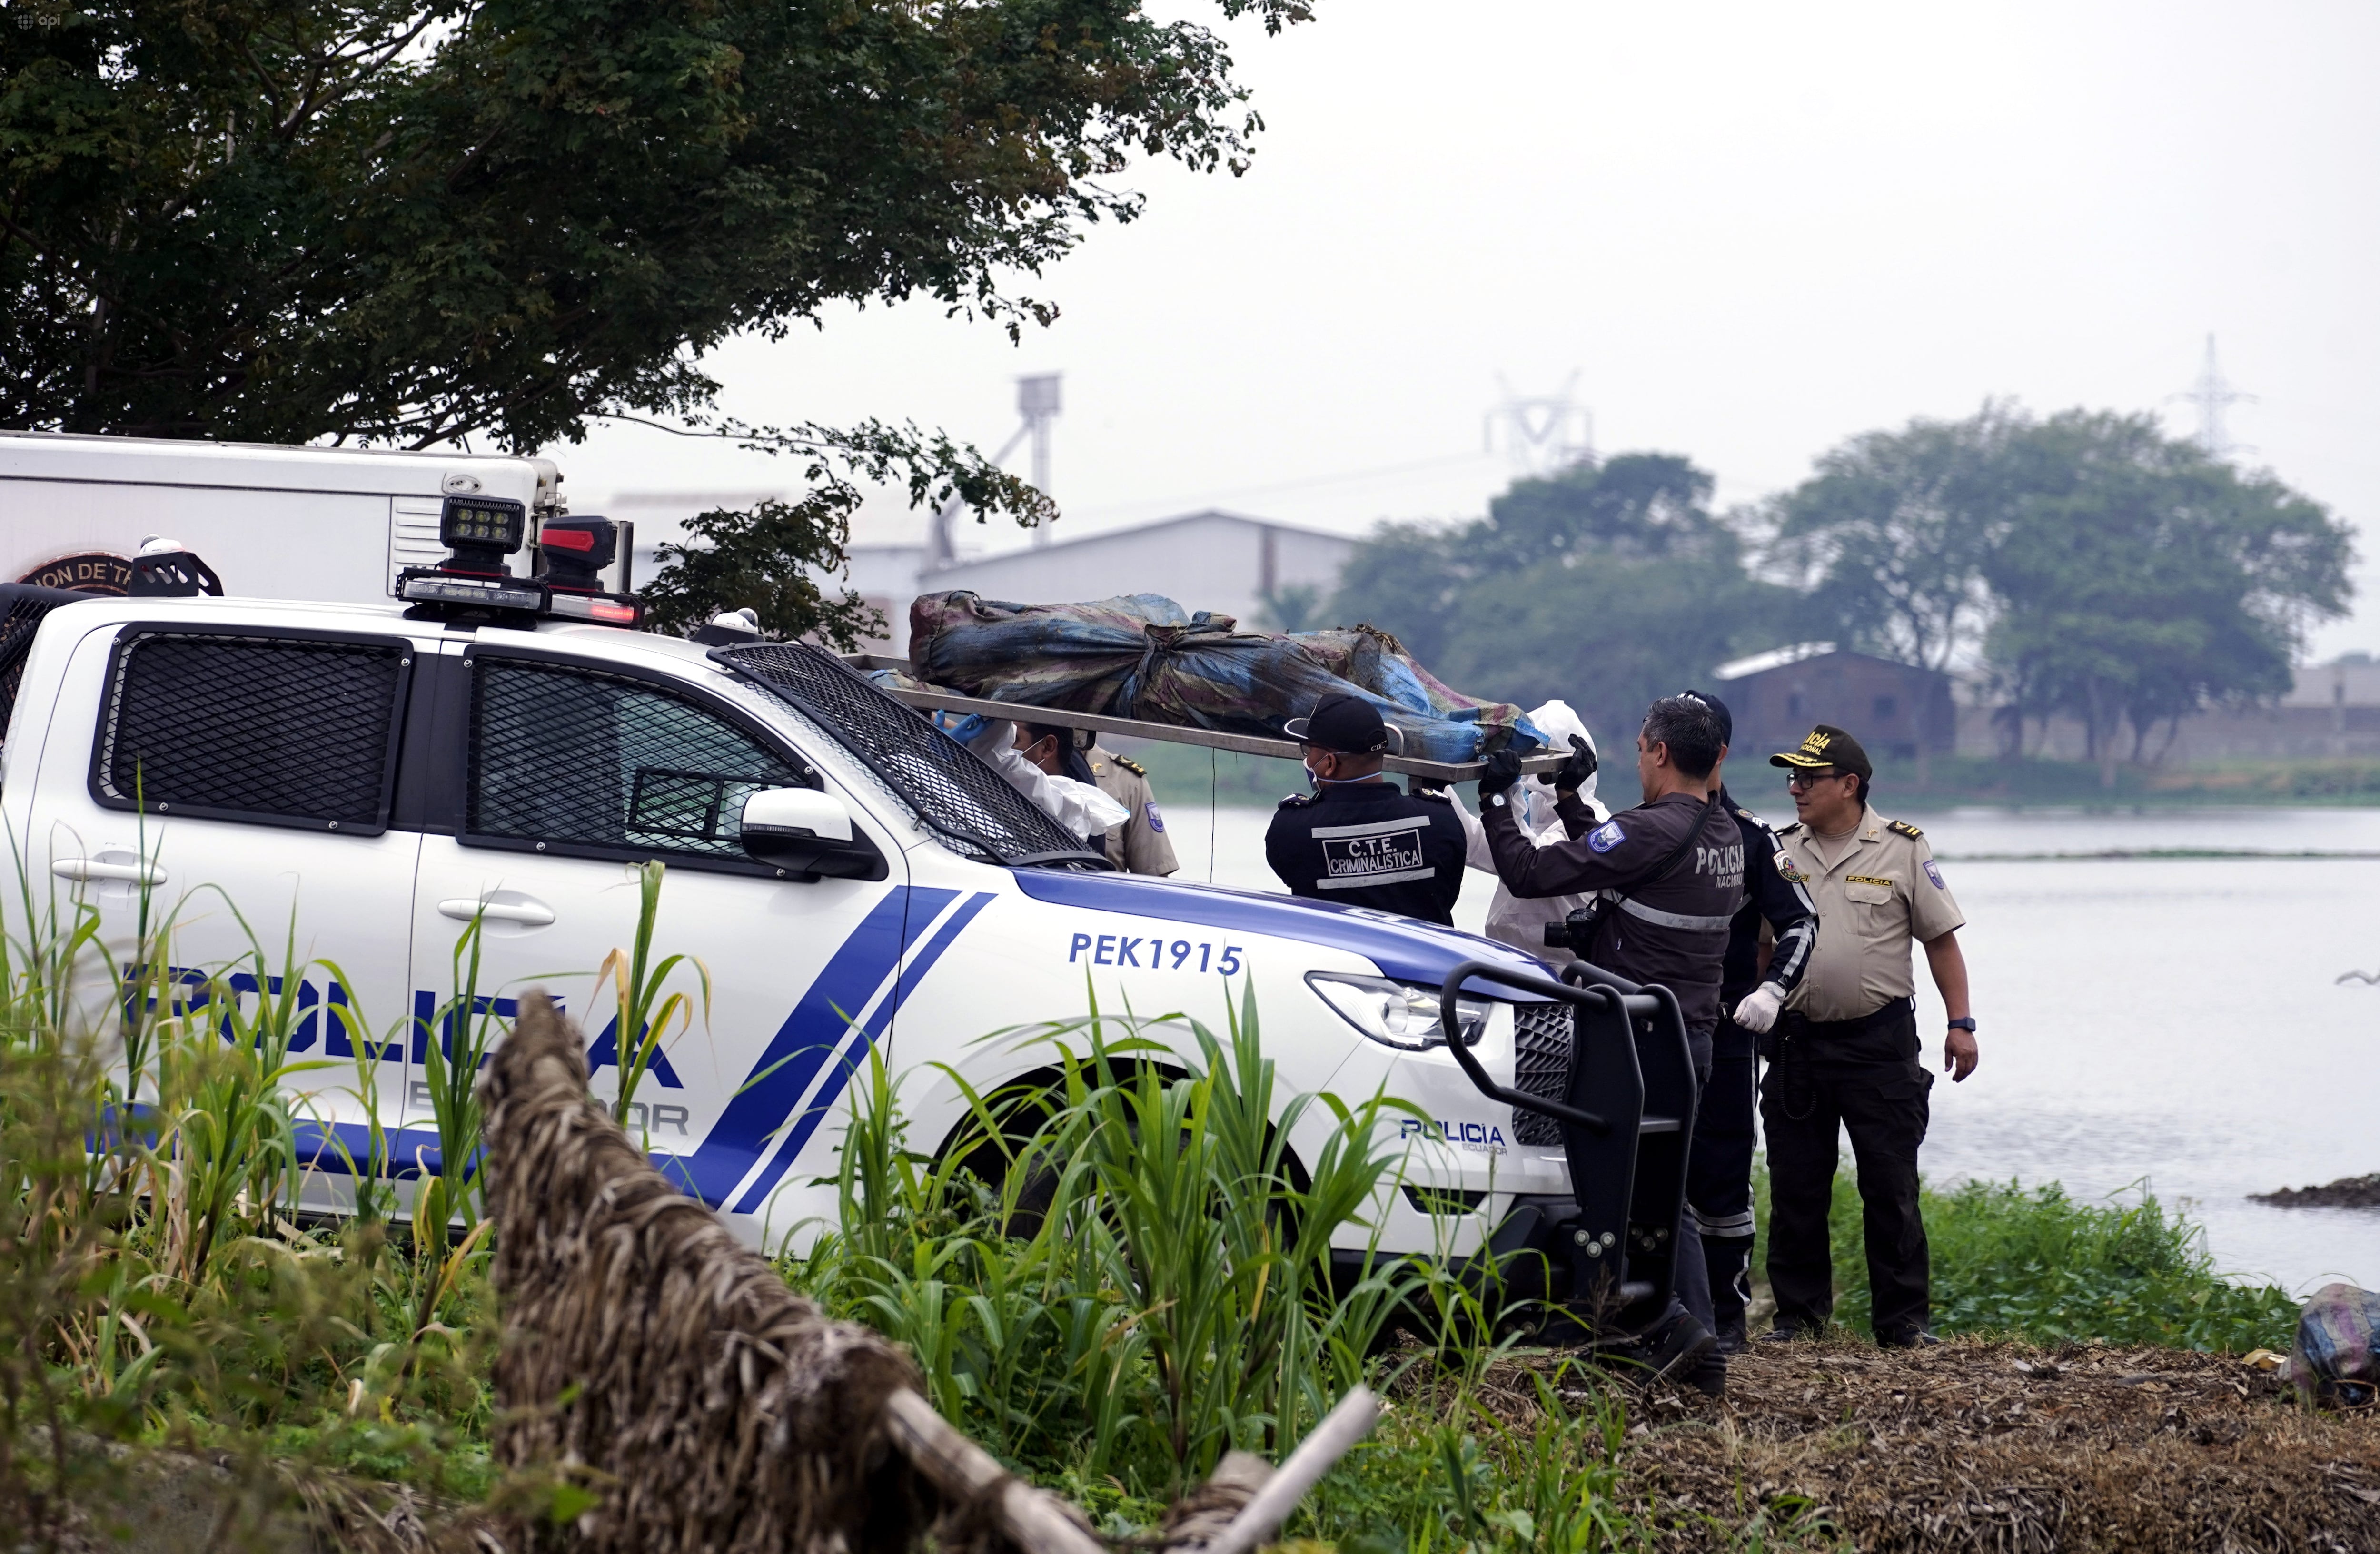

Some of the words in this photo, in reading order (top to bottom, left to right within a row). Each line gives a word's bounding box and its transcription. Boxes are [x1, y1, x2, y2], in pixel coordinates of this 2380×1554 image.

[78, 563, 107, 580] DE
[1348, 838, 1397, 857] C.T.E.
[1330, 850, 1420, 873] CRIMINALISTICA
[1695, 844, 1745, 875] POLICIA
[1847, 876, 1891, 886] POLICIA
[1069, 933, 1243, 976] PEK1915
[120, 962, 684, 1089] POLICA
